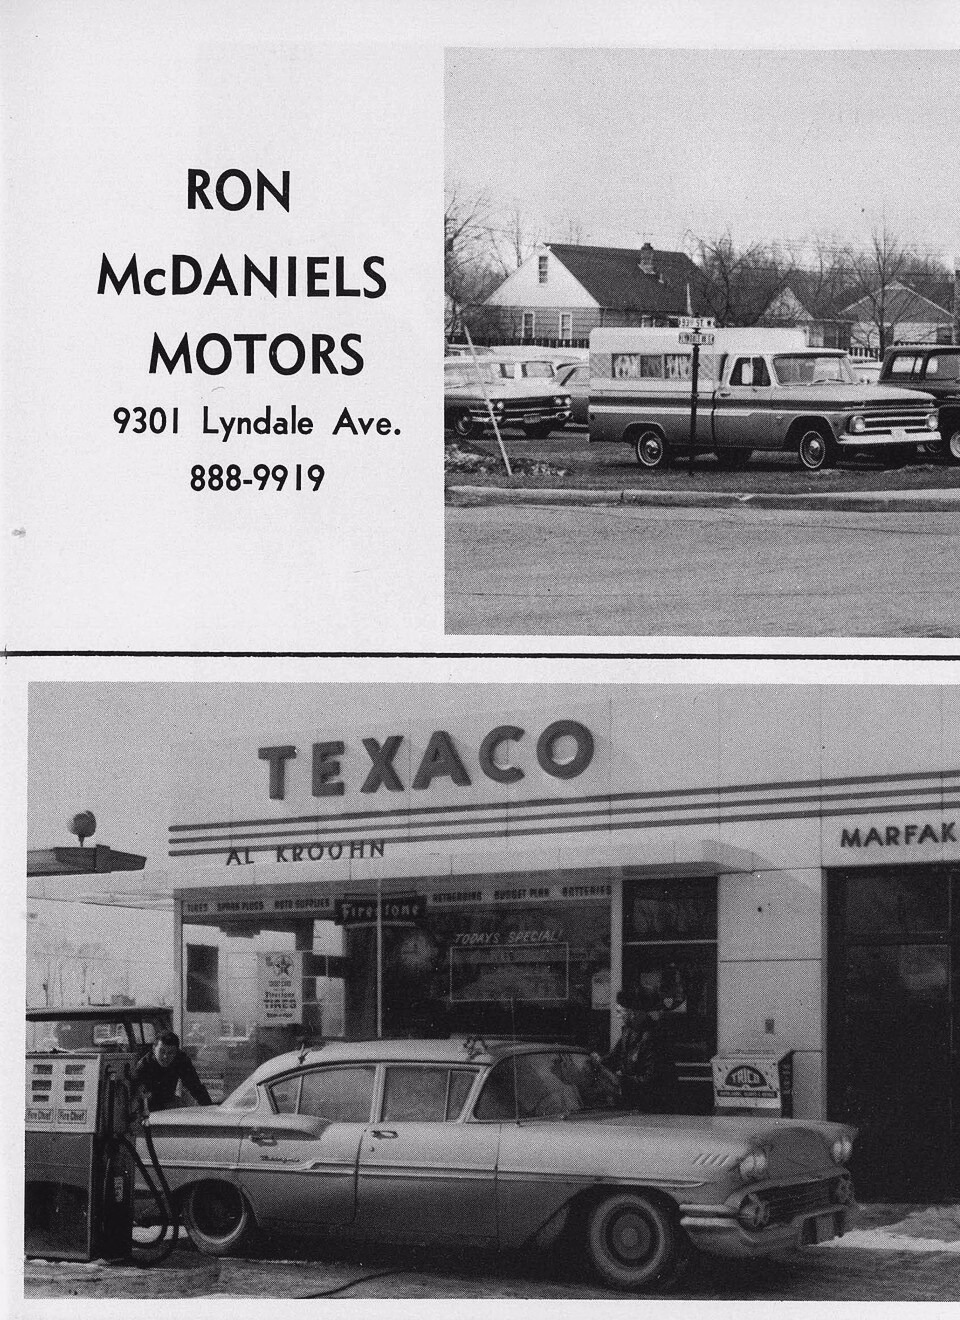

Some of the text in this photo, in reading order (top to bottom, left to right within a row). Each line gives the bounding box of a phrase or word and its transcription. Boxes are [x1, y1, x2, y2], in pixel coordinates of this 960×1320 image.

[188, 169, 290, 212] RON
[98, 253, 386, 298] McDANIELS
[149, 332, 363, 376] MOTORS
[114, 405, 402, 442] 9301 Lyndale Ave.
[191, 464, 324, 492] 888-9919
[257, 719, 596, 800] TEXACO
[226, 839, 385, 866] AL KROOHN
[840, 821, 957, 848] MARFAK
[341, 903, 419, 920] Firetone
